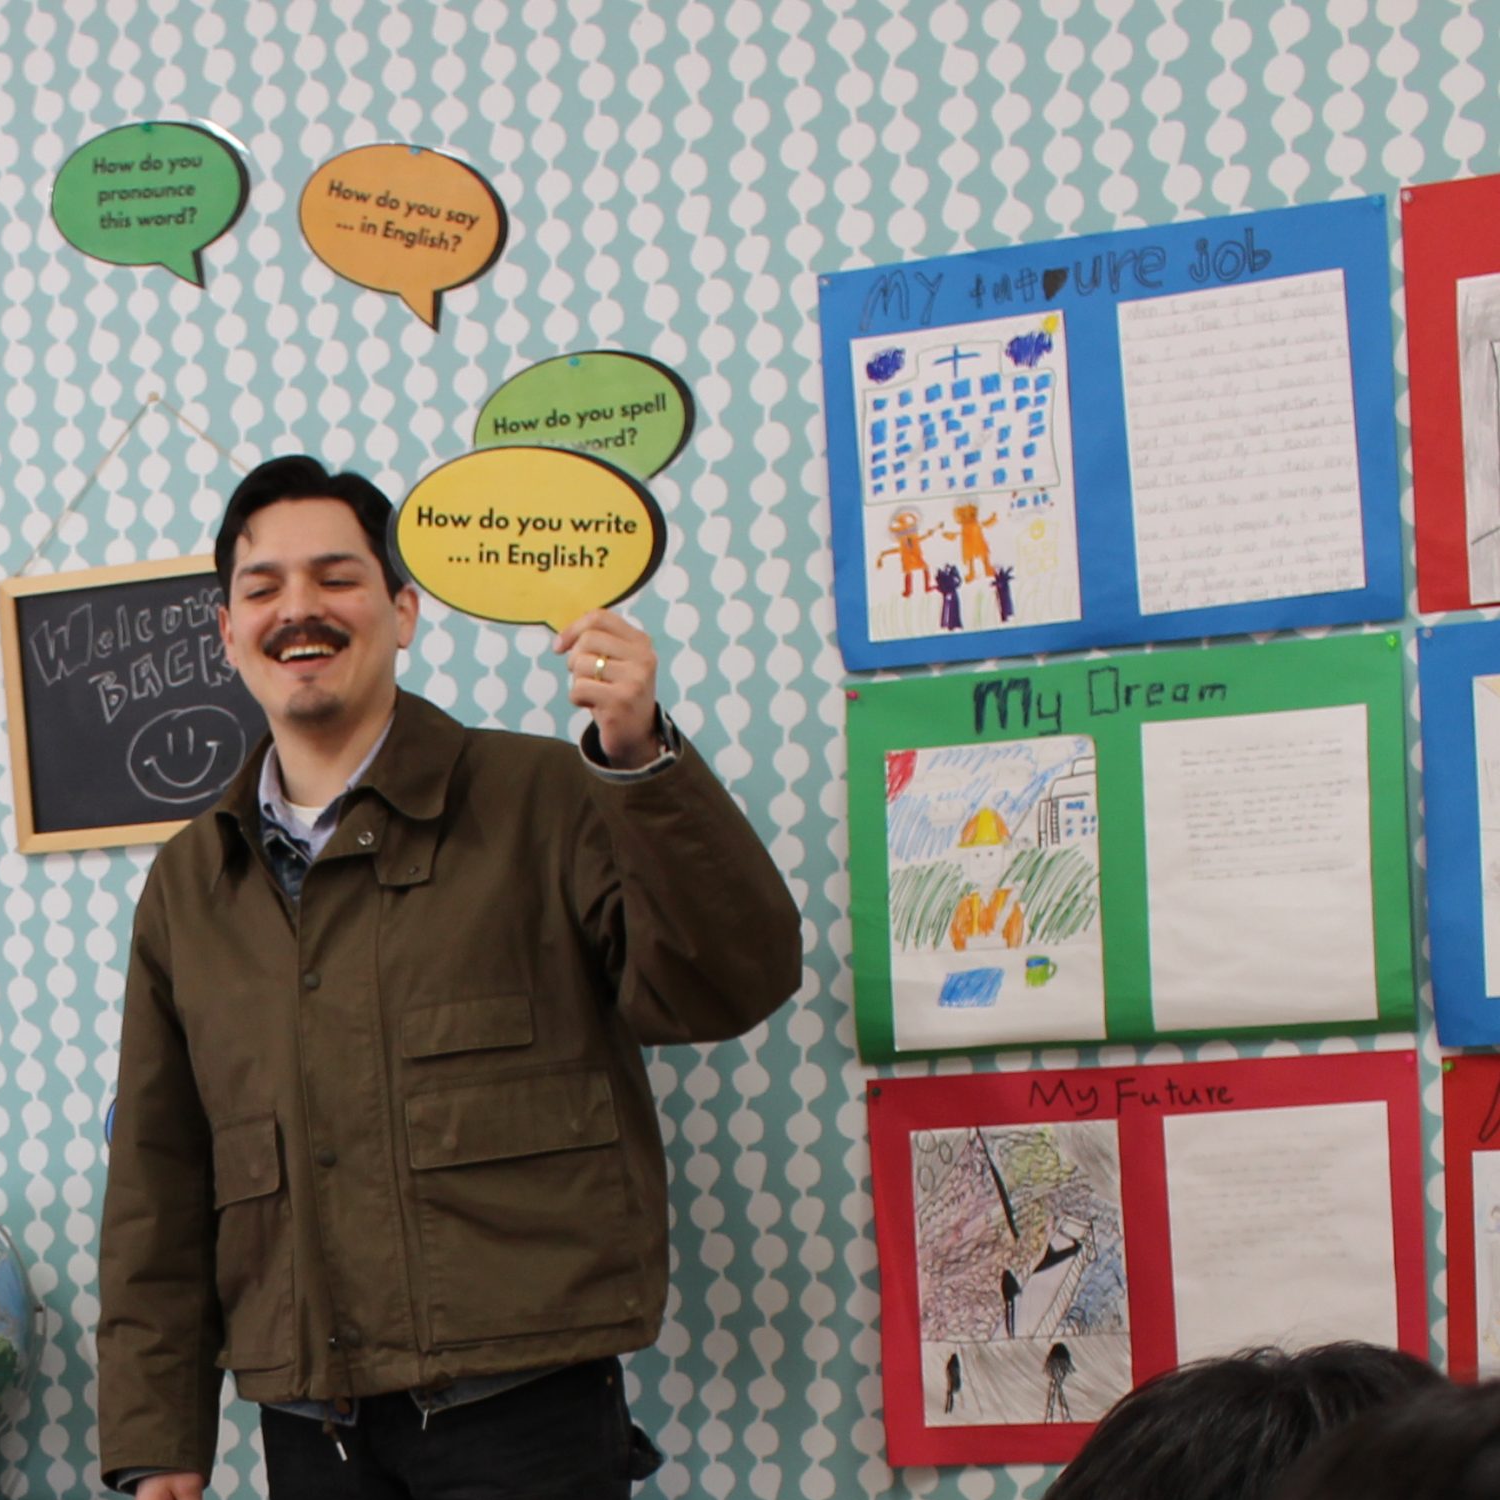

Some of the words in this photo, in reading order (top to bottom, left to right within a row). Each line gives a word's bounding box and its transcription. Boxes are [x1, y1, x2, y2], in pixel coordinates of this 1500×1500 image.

[93, 157, 133, 174] How
[139, 155, 163, 172] do
[166, 154, 202, 174] you
[97, 181, 196, 207] pronounce
[328, 180, 370, 204] How
[376, 189, 400, 209] do
[406, 199, 442, 222] you
[445, 209, 479, 232] say
[100, 210, 130, 229] this
[134, 206, 197, 227] word?
[360, 215, 378, 234] in
[382, 221, 462, 253] English?
[493, 417, 540, 435] How
[546, 409, 570, 428] do
[576, 407, 614, 429] you
[620, 393, 667, 421] spell
[417, 506, 471, 528] How
[479, 507, 509, 529] do
[517, 516, 562, 536] you
[571, 512, 637, 534] write
[479, 543, 499, 564] in
[507, 544, 610, 572] English?
[29, 587, 223, 687] Welcom
[972, 677, 1062, 735] My
[1088, 666, 1227, 716] Dream
[1029, 1078, 1098, 1117] My
[1114, 1077, 1234, 1116] Future
